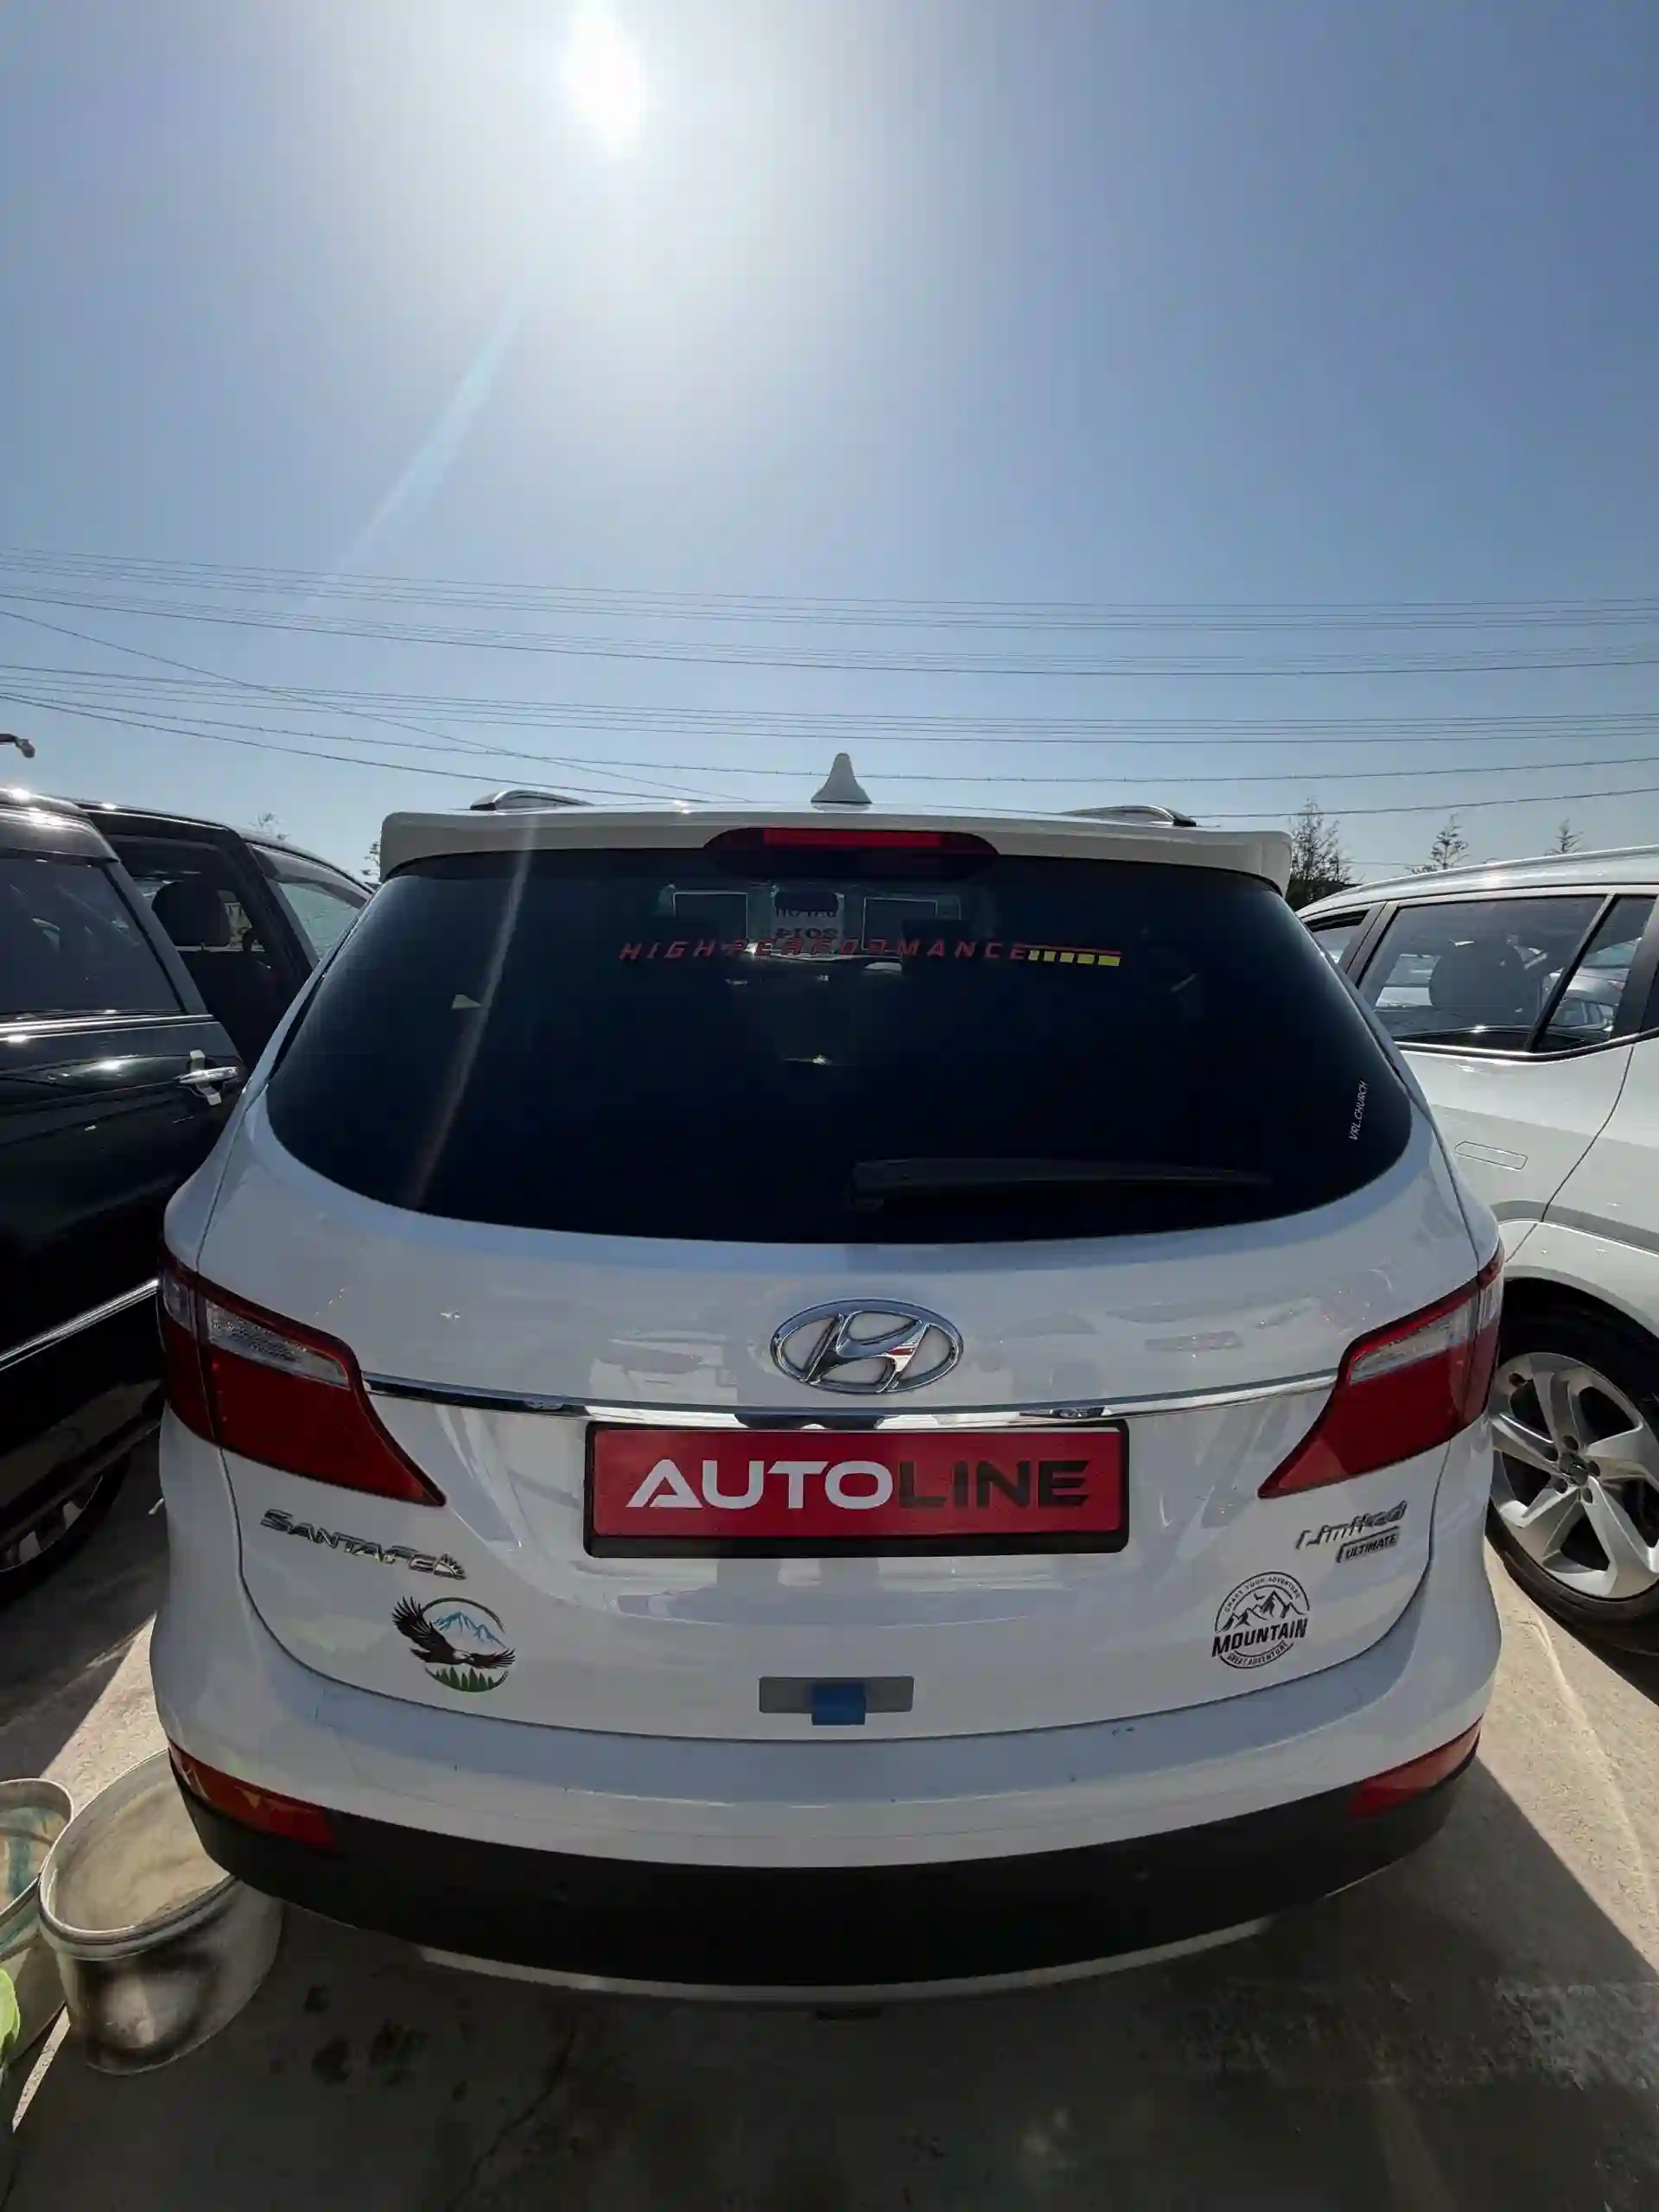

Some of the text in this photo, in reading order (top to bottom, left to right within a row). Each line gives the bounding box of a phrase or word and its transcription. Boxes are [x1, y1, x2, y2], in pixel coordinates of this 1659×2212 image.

[1349, 1080, 1368, 1141] VRL.CHURCH
[626, 1459, 1090, 1510] AUTOLINE
[1344, 1533, 1398, 1560] ULTIMATE
[1211, 1618, 1308, 1657] MOUNTAIN
